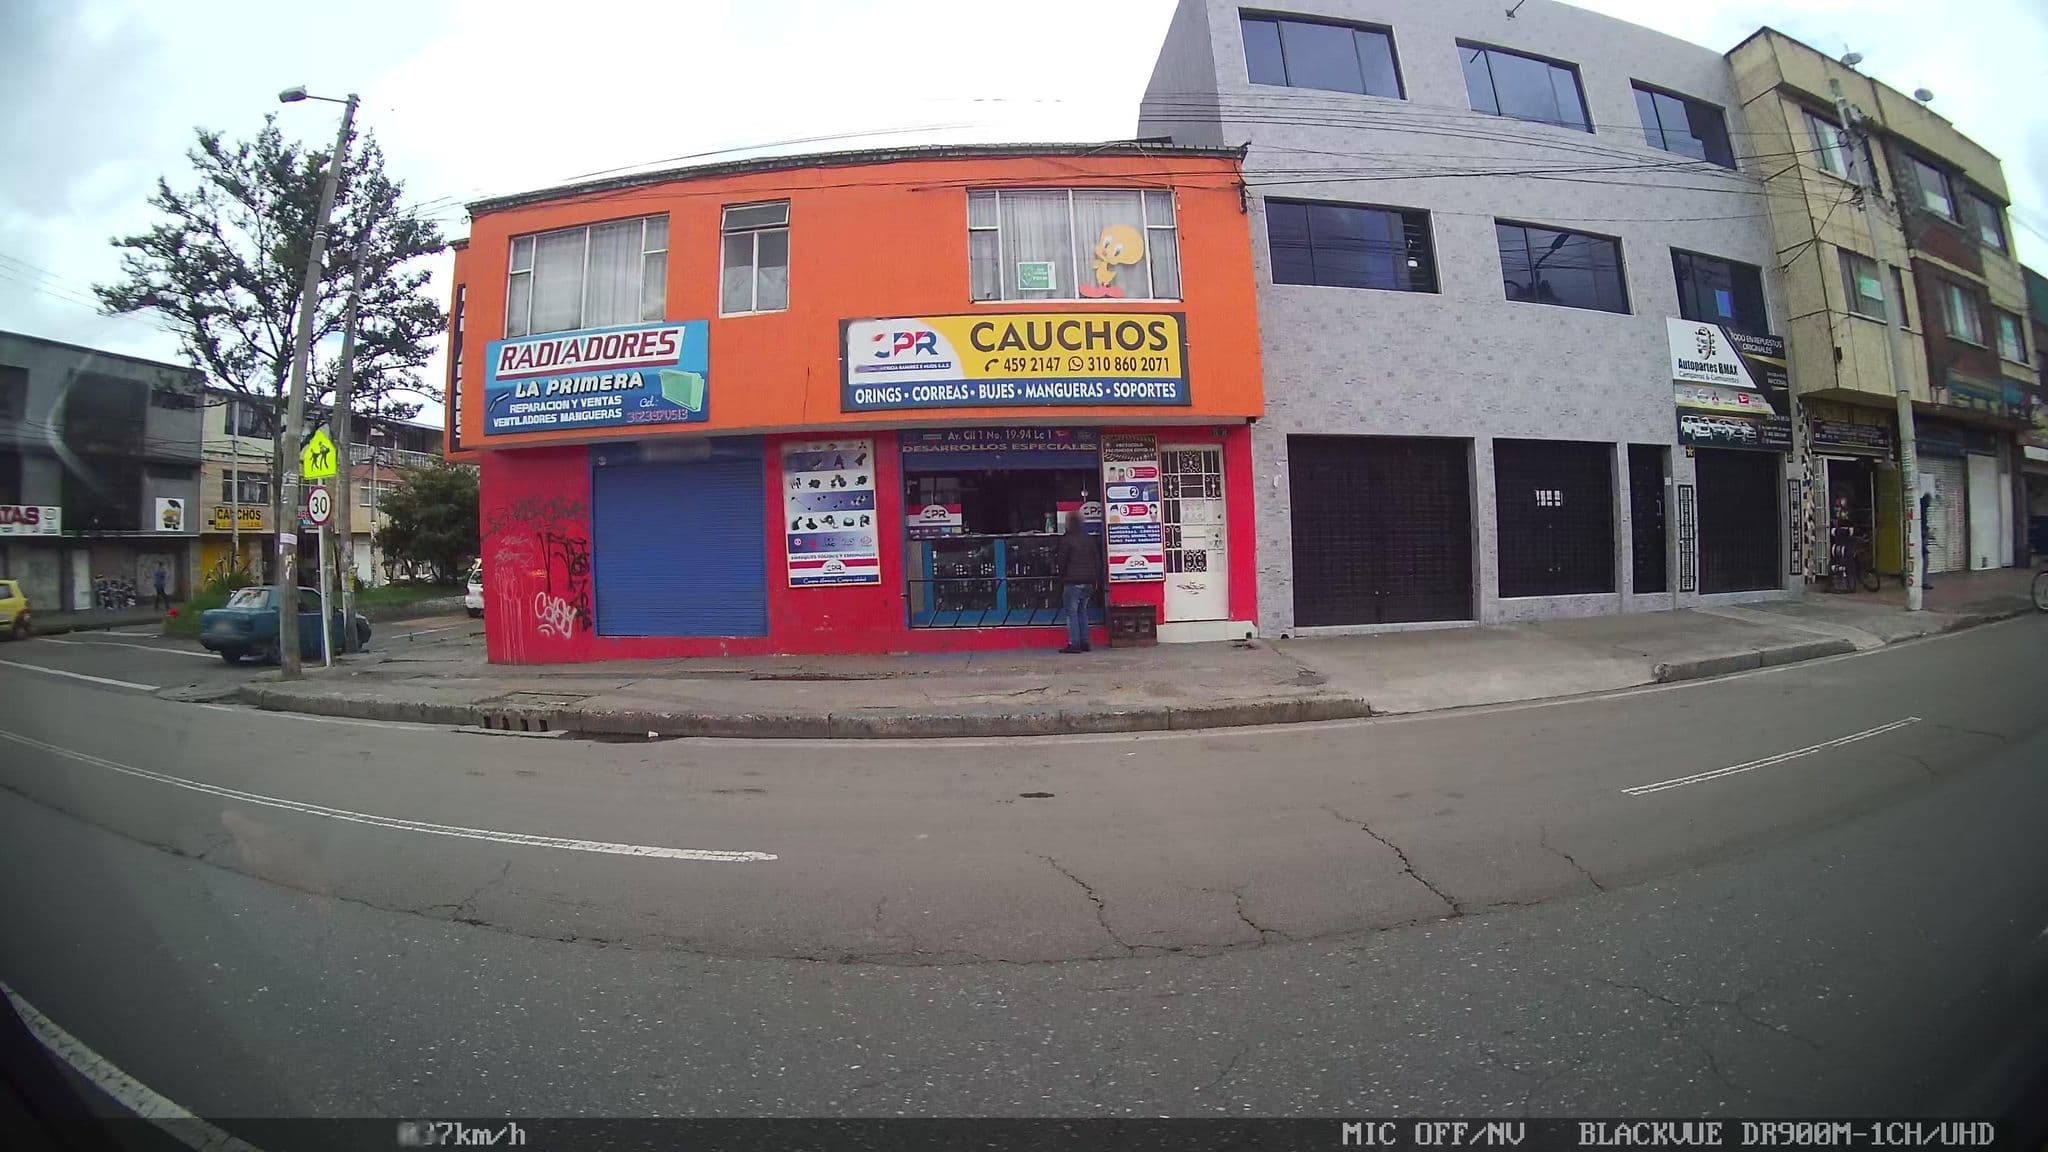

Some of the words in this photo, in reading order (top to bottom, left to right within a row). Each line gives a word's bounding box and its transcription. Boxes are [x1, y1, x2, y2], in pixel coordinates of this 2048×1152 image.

[970, 320, 1169, 353] CAUCHOS
[500, 329, 679, 371] RADIADORES
[1004, 357, 1026, 372] 459
[1030, 357, 1060, 372] 2147
[1088, 356, 1110, 371] 310
[1115, 356, 1136, 371] 860
[1141, 356, 1169, 371] 2071
[1678, 358, 1718, 374] Autopartes
[515, 378, 541, 398] LA
[546, 371, 645, 396] PRIMERA
[855, 388, 902, 404] ORINGS
[912, 385, 968, 402] CORREAS
[978, 383, 1015, 399] BUJES
[1025, 382, 1104, 399] MANGUERAS
[1113, 382, 1176, 398] SOPORTES
[510, 399, 570, 414] REPARACION
[572, 400, 579, 409] Y
[581, 395, 622, 407] VENTAS
[493, 413, 557, 428] VENTILADORES
[560, 409, 622, 422] MANGUERAS
[986, 431, 1003, 440] No.
[902, 443, 1008, 453] DESARROLLOS
[1012, 443, 1098, 451] ESPECIALES
[1132, 488, 1137, 496] 2
[312, 496, 328, 514] 30
[0, 507, 39, 525] TAS
[217, 509, 261, 520] CACHOS
